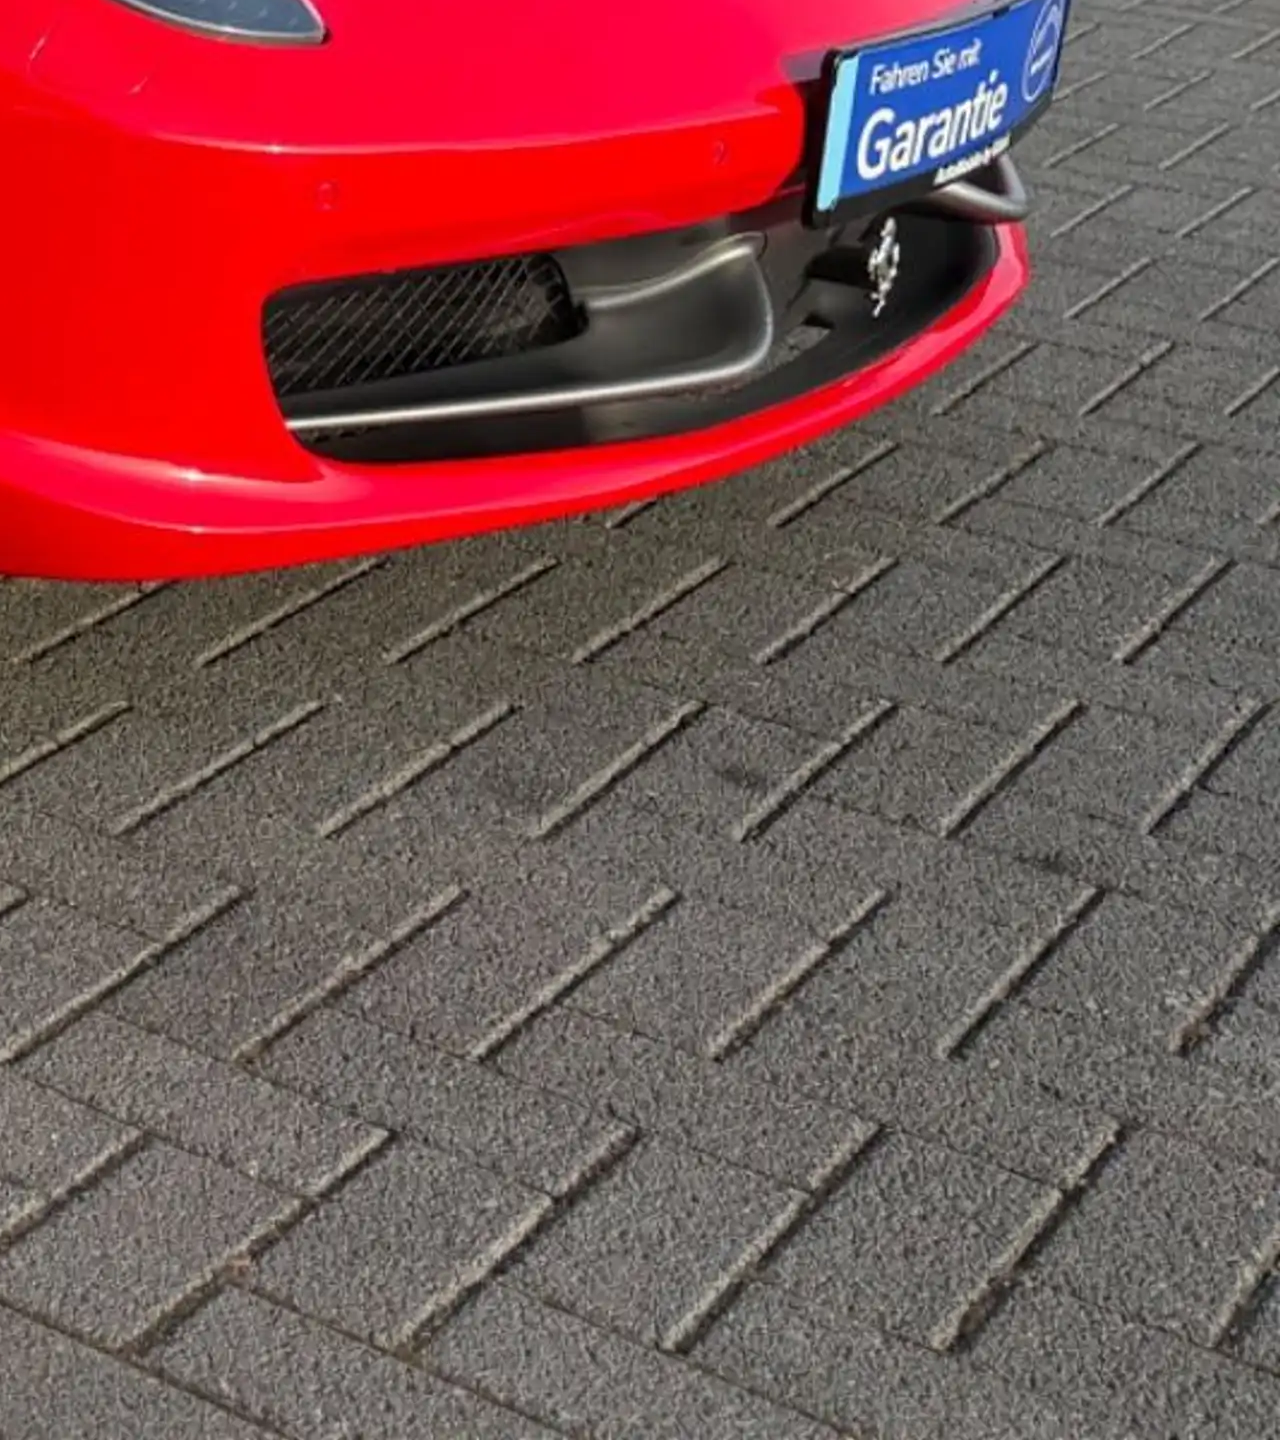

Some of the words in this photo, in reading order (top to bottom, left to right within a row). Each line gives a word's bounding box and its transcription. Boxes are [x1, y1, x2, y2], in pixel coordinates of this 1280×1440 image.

[869, 61, 929, 95] Fahren
[932, 47, 956, 78] Sie
[857, 69, 1008, 180] Garantie
